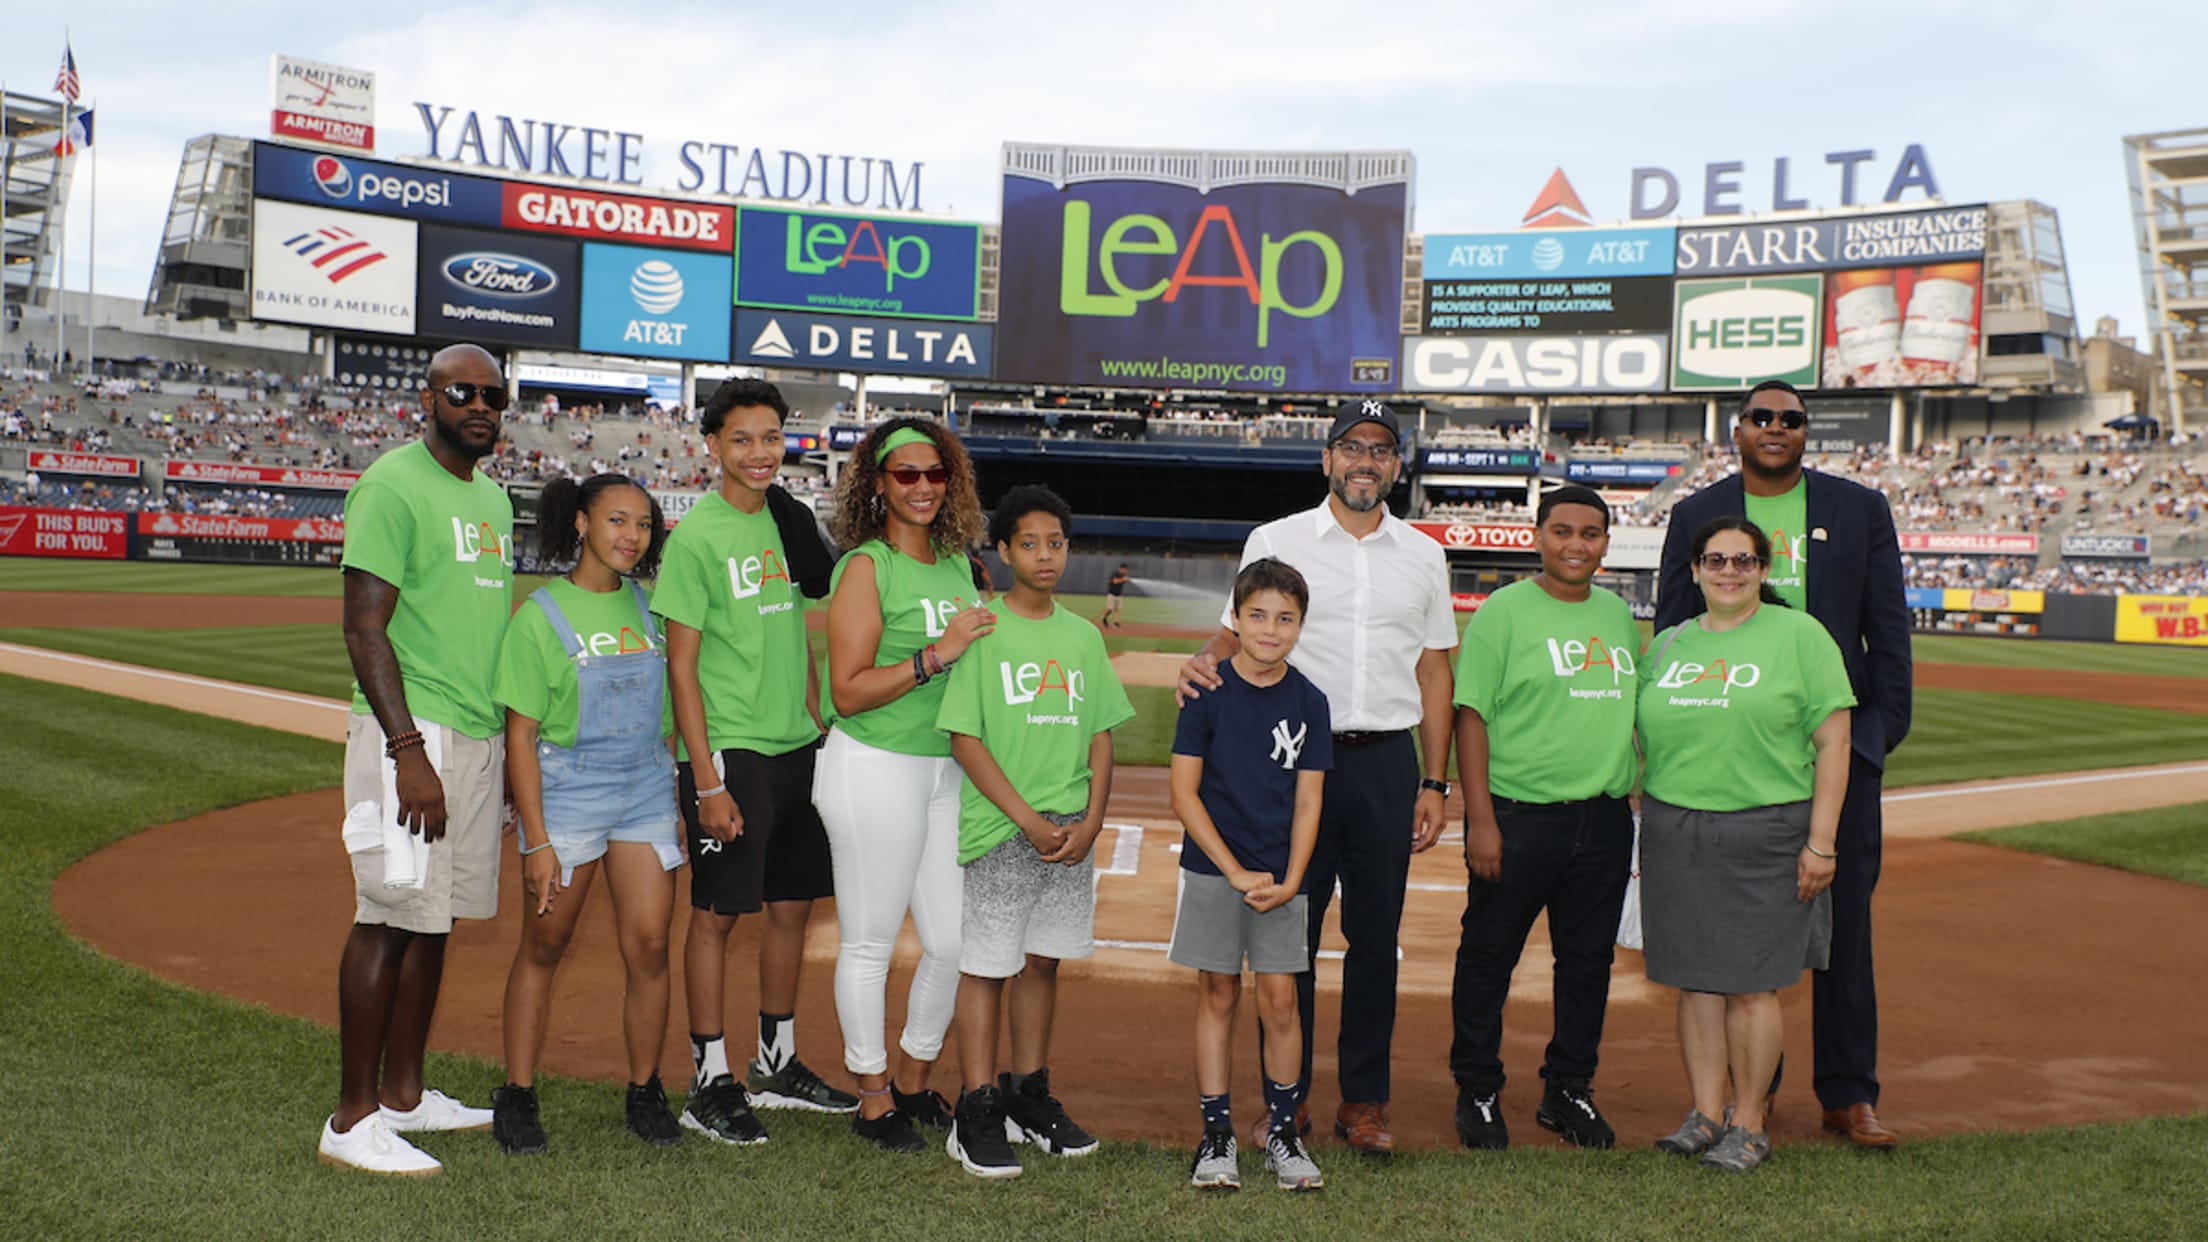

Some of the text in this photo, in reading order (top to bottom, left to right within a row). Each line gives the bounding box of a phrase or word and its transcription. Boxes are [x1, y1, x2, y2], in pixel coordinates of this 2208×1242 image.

[281, 63, 371, 90] ARMITRON
[283, 113, 366, 137] ARMITRON
[413, 102, 925, 211] YANKEE STADIUM
[358, 173, 451, 208] pepsi
[1630, 143, 1941, 220] DELTA
[518, 191, 720, 242] GATORADE
[1846, 209, 1987, 242] INSURANCE
[1448, 244, 1509, 267] AT&T
[1587, 240, 1649, 265] AT&T
[1677, 226, 1827, 270] STARR
[1844, 231, 1987, 262] COMPANIES
[464, 257, 537, 292] Ford
[1432, 285, 1444, 297] IS
[1457, 284, 1520, 297] SUPPORTER
[1522, 284, 1538, 297] OF
[1572, 282, 1612, 296] WHICH
[255, 289, 410, 318] BANK OF AMERICA
[442, 303, 555, 328] BuyFordNow.com
[806, 293, 902, 311] www.leapnyc.org
[1431, 299, 1615, 315] PROVIDES QUALITY EDUCATIONAL
[624, 319, 687, 347] AT&T
[1429, 315, 1540, 328] ARTS PROGRAMS TO
[1689, 316, 1804, 350] HESS
[809, 324, 977, 365] DELTA
[1101, 356, 1287, 388] www.leapnyc.org
[1414, 338, 1661, 388] CASIO
[35, 513, 73, 532] THIS
[77, 515, 124, 534] BUD'S
[1478, 527, 1533, 546] TOYO
[35, 532, 67, 550] FOR
[71, 533, 108, 552] YOU.
[1767, 528, 1808, 574] Ap
[728, 548, 799, 600] LeA
[2156, 614, 2208, 639] W.B.
[1269, 719, 1307, 770] NY
